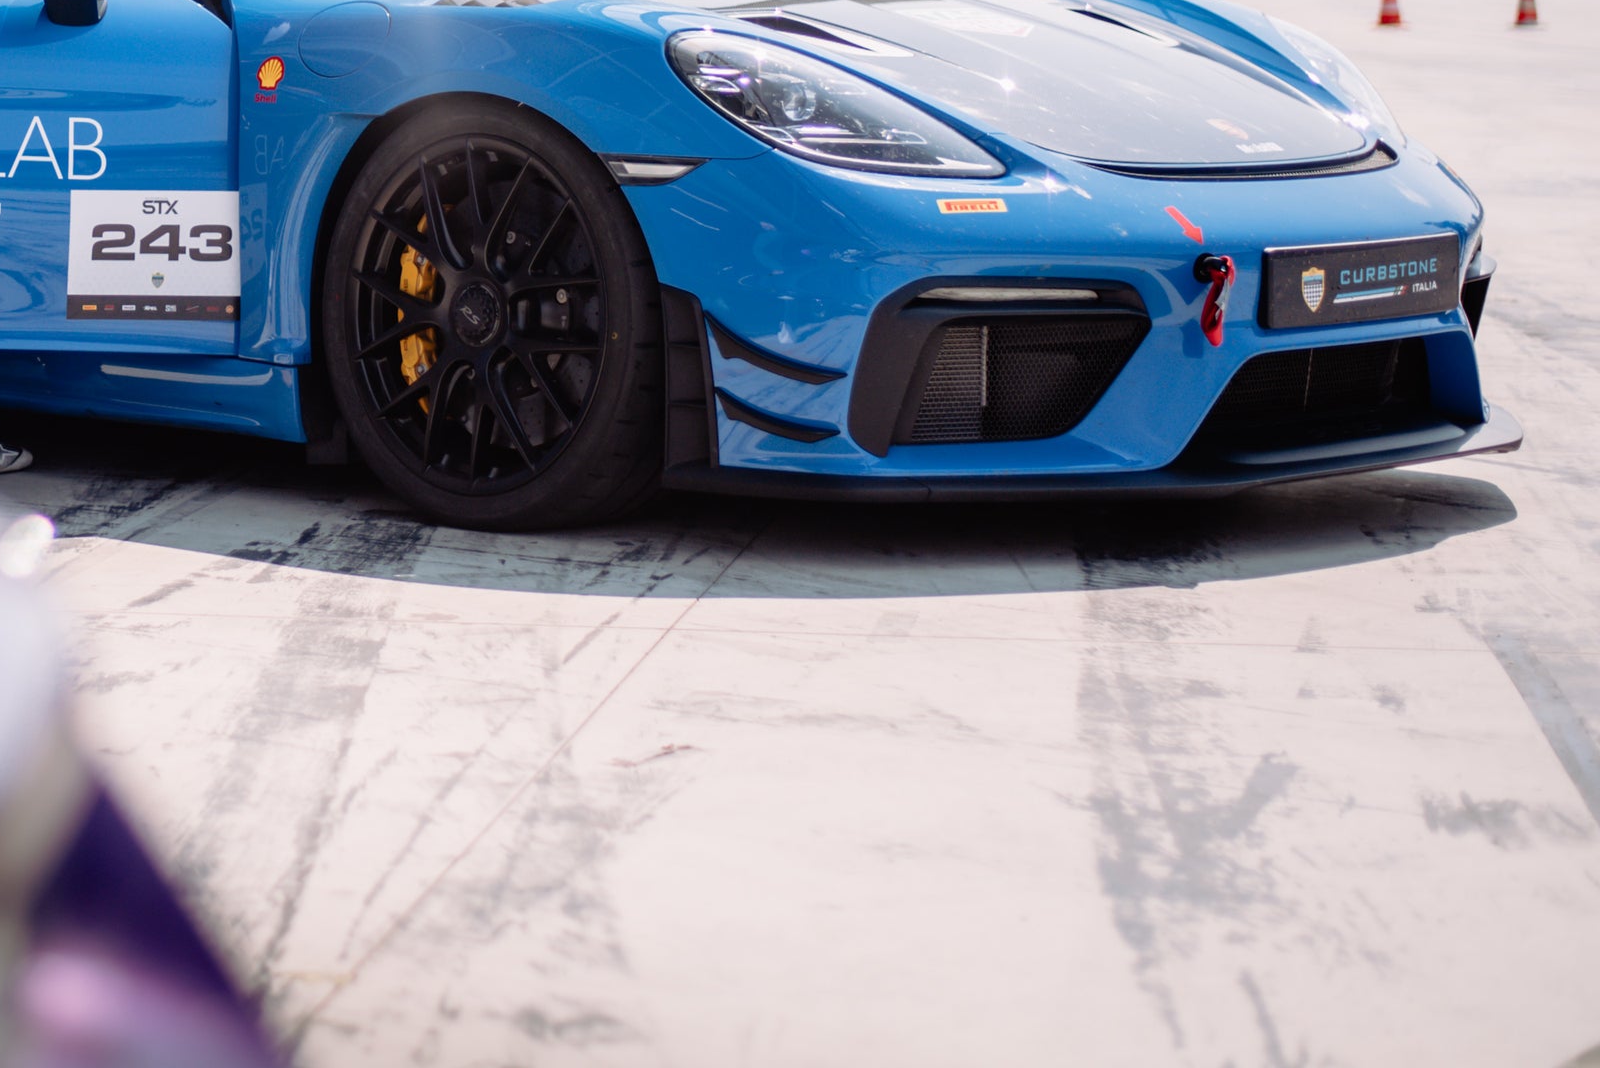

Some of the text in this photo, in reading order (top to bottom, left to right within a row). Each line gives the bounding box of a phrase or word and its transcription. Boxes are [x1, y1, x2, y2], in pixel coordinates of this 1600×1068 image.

[254, 92, 277, 103] Shell
[142, 200, 179, 215] STX
[944, 200, 999, 212] PIRELLI
[91, 223, 233, 262] 243
[1340, 257, 1438, 285] CURBSTONE
[1411, 280, 1438, 292] ITALIA
[460, 305, 481, 325] RS
